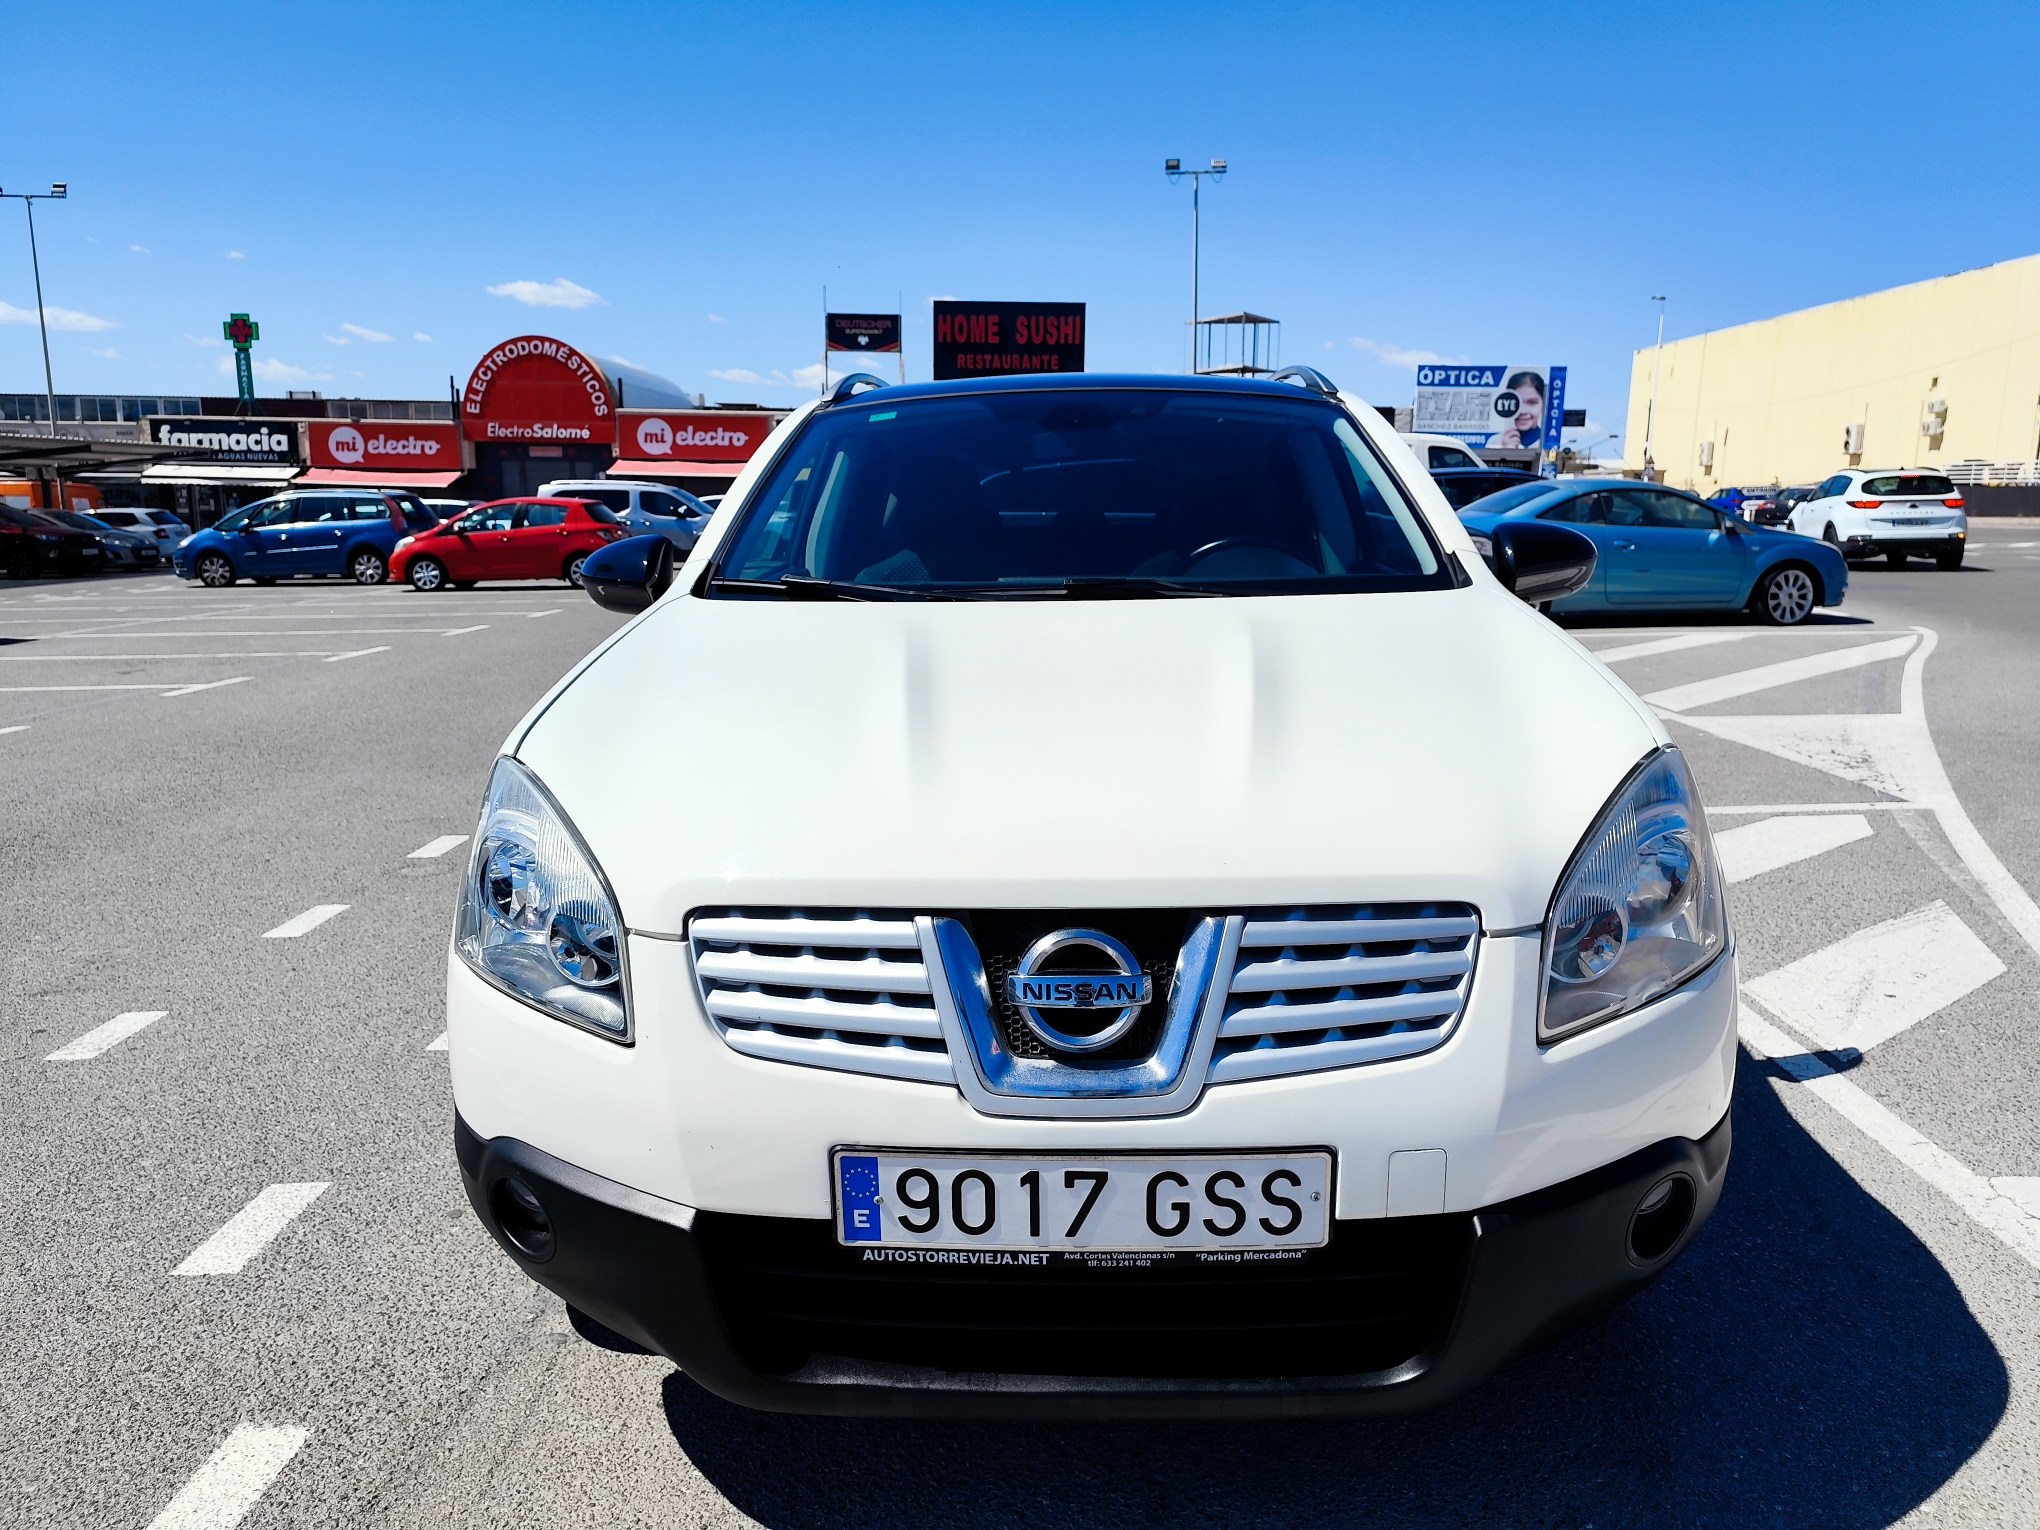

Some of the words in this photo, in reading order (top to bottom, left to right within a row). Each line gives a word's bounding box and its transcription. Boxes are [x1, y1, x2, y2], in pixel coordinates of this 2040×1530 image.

[938, 314, 1000, 343] HOME
[1015, 315, 1081, 345] SUSHI
[957, 354, 1059, 370] RESTAURANTE
[466, 340, 609, 417] ELECTRODOMÉSTICOS
[1419, 366, 1495, 385] ÓPTICA
[1496, 398, 1517, 411] EYE
[158, 424, 289, 451] farmacia
[487, 422, 591, 439] ElectroSalomé
[643, 428, 667, 444] mi
[675, 425, 749, 447] electro
[335, 436, 359, 452] mi
[367, 433, 442, 455] electro
[217, 452, 245, 460] AGUAS
[247, 453, 279, 461] NUEVAS
[1022, 982, 1137, 1002] NISSAN
[853, 1209, 871, 1227] E
[896, 1167, 1109, 1237] 9017
[1145, 1168, 1303, 1238] GSS
[863, 1249, 1050, 1266] AUTOSTORREVIEJA.NET
[1064, 1252, 1083, 1260] Avd.
[1084, 1252, 1111, 1260] Cortes
[1112, 1252, 1161, 1260] Valencianas
[1162, 1252, 1175, 1260] s/n
[1088, 1259, 1100, 1267] tlf:
